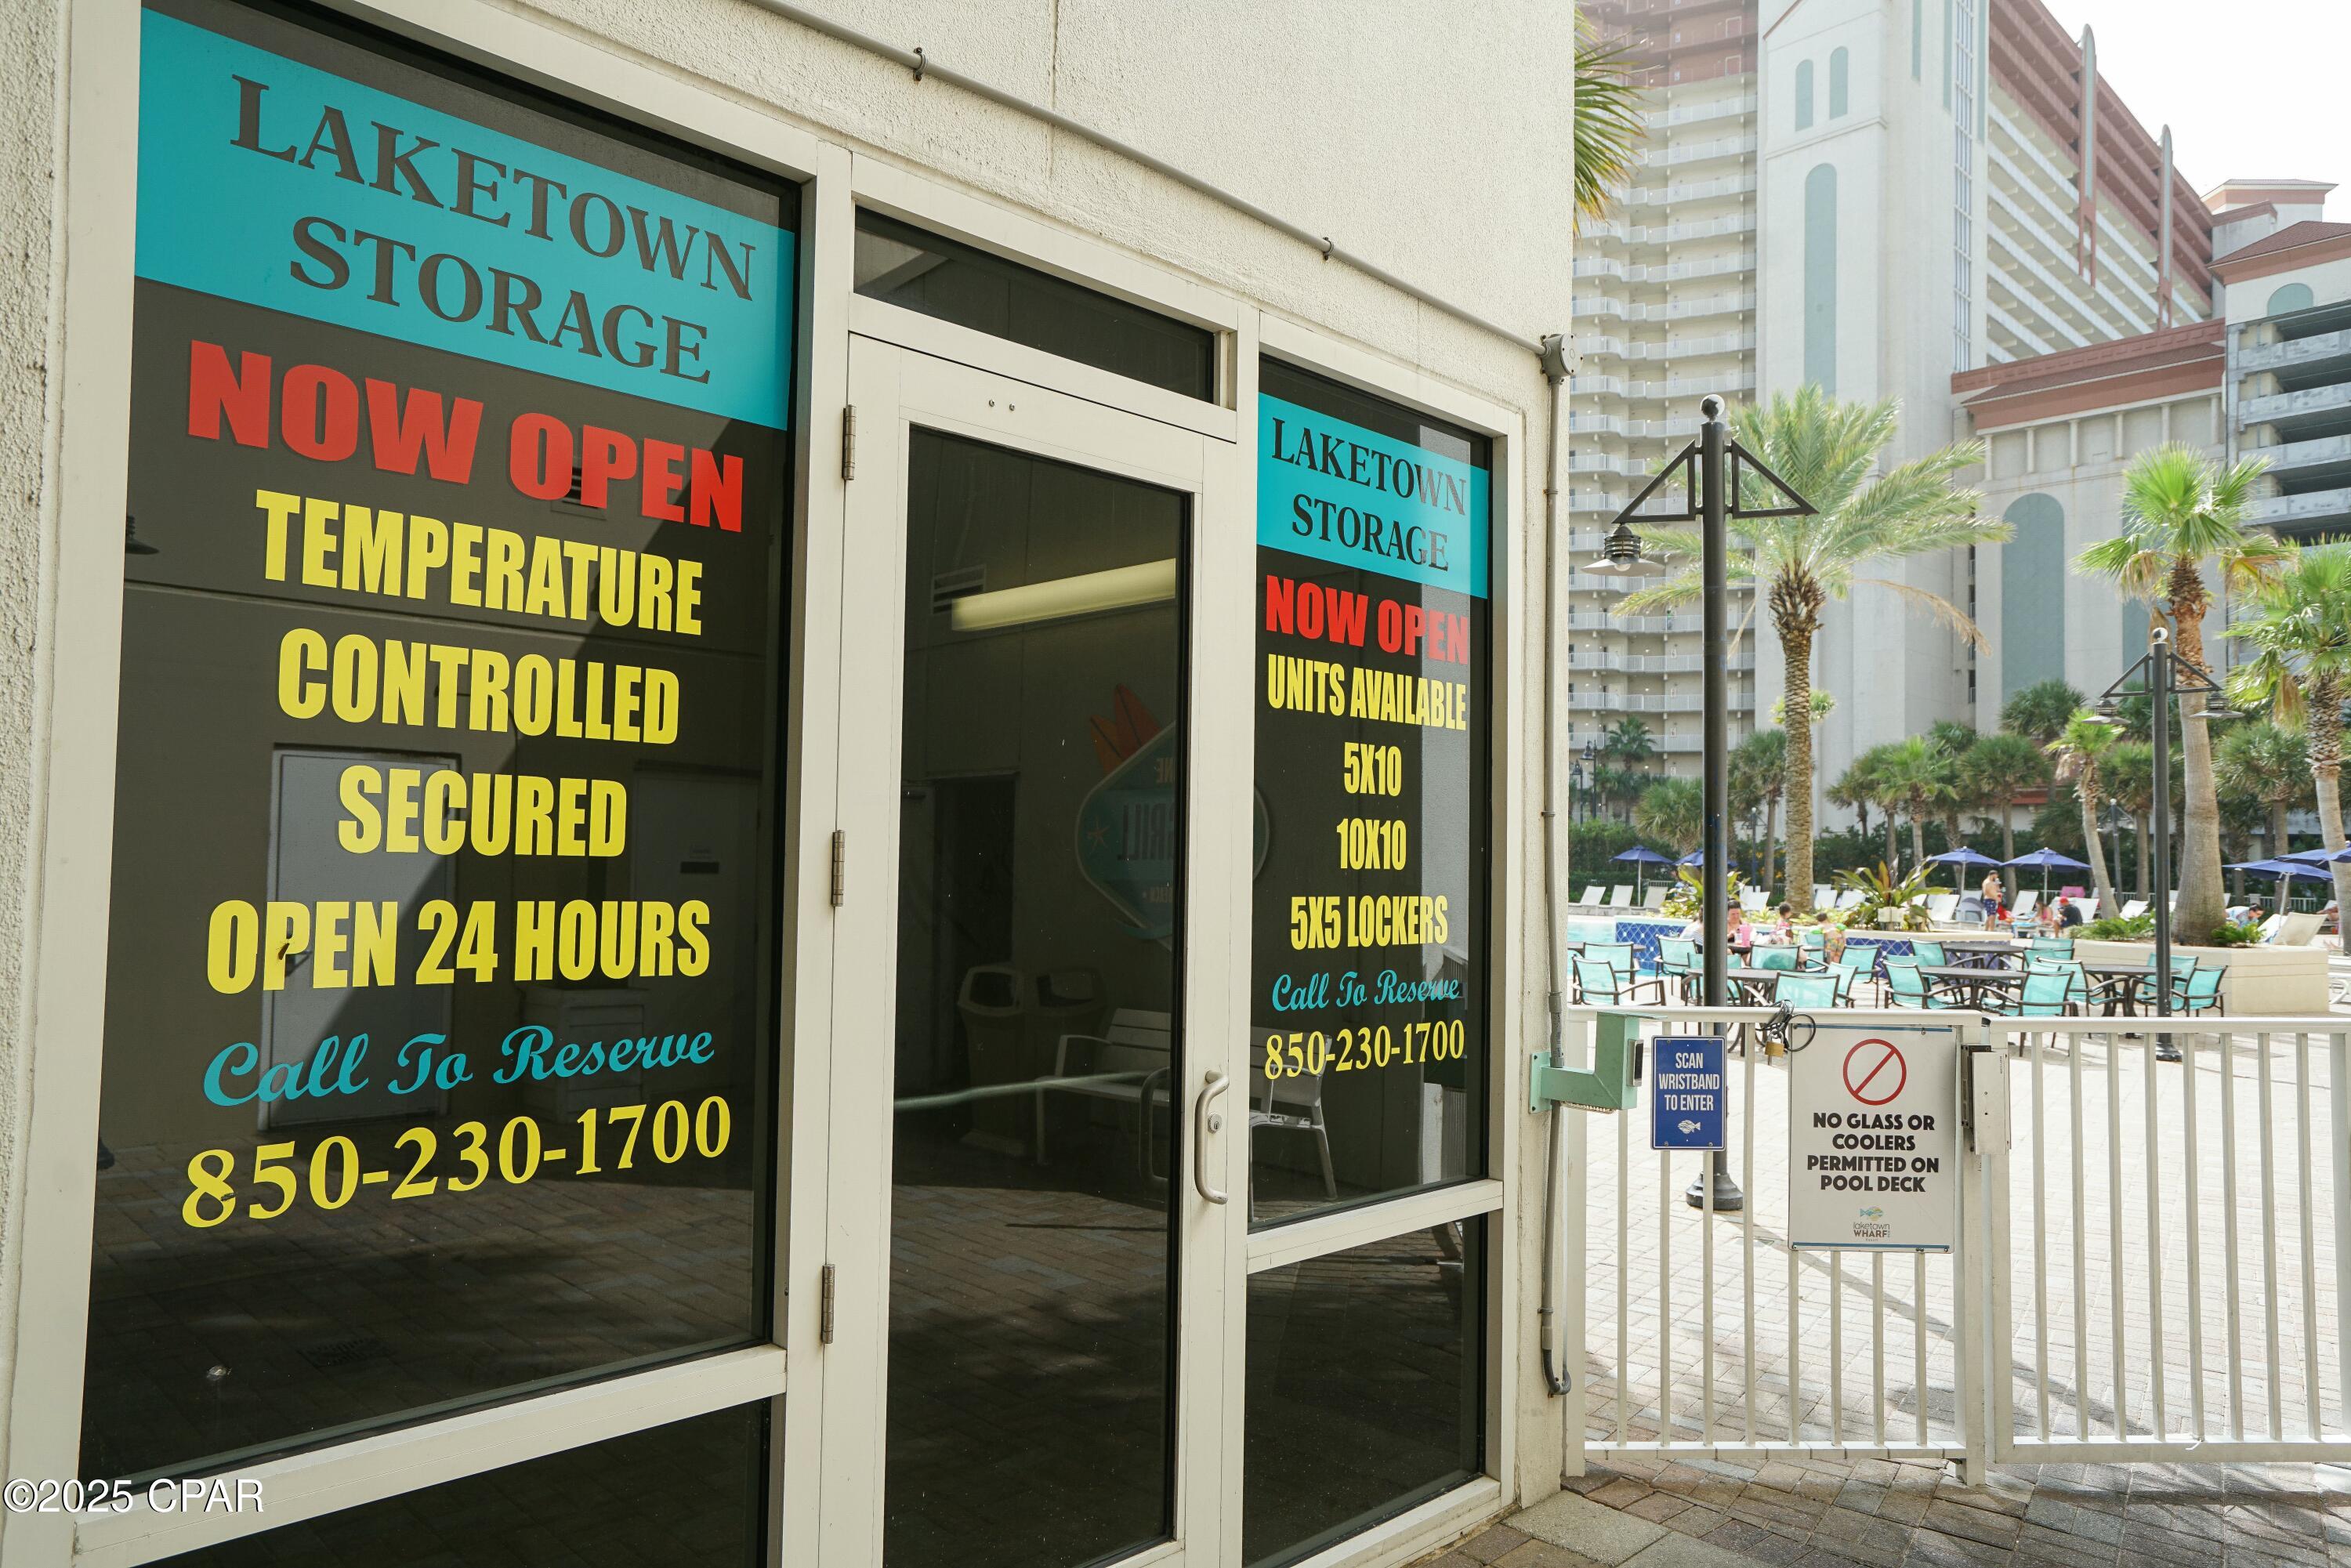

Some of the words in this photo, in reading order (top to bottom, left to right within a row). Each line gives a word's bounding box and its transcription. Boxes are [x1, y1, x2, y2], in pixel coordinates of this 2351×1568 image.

[230, 74, 756, 302] LAKETOWN
[290, 216, 711, 385] STORAGE
[188, 340, 484, 484] NOW
[510, 413, 744, 533] OPEN
[1271, 417, 1467, 516] LAKETOWN
[255, 490, 703, 636] TEMPERATURE
[1291, 494, 1449, 572] STORAGE
[1266, 574, 1369, 647] NOW
[1378, 599, 1469, 665] OPEN
[278, 628, 679, 744] CONTROLLED
[1267, 654, 1346, 716] UNITS
[1349, 667, 1466, 731] AVAILABLE
[1343, 741, 1402, 797] 5X10
[338, 765, 627, 857] SECURED
[1336, 817, 1407, 871] 10X10
[207, 900, 398, 994] OPEN
[415, 900, 498, 985] 24
[514, 899, 711, 982] HOURS
[1291, 896, 1342, 951] 5X5
[1347, 895, 1447, 947] LOCKERS
[1272, 972, 1330, 1012] Call
[1335, 971, 1367, 1008] To
[1375, 969, 1460, 1005] Reserve
[203, 1033, 369, 1106] Call
[387, 1033, 473, 1095] To
[494, 1025, 715, 1085] Reserve
[1264, 1019, 1465, 1080] 850-230-1700
[1675, 1052, 1704, 1069] SCAN
[1658, 1073, 1720, 1090] WRISTBAND
[1664, 1094, 1678, 1111] TO
[1680, 1094, 1714, 1111] ENTER
[1813, 1112, 1842, 1128] NO
[1846, 1113, 1904, 1130] GLASS
[1907, 1114, 1935, 1131] OR
[1832, 1133, 1916, 1151] COOLERS
[182, 1095, 731, 1228] 850-230-1700
[1807, 1154, 1907, 1172] PERMITTED
[1911, 1157, 1940, 1173] ON
[1820, 1175, 1874, 1191] POOL
[1877, 1176, 1926, 1193] DECK
[1853, 1222, 1890, 1230] laketown
[1853, 1229, 1888, 1238] WHARF
